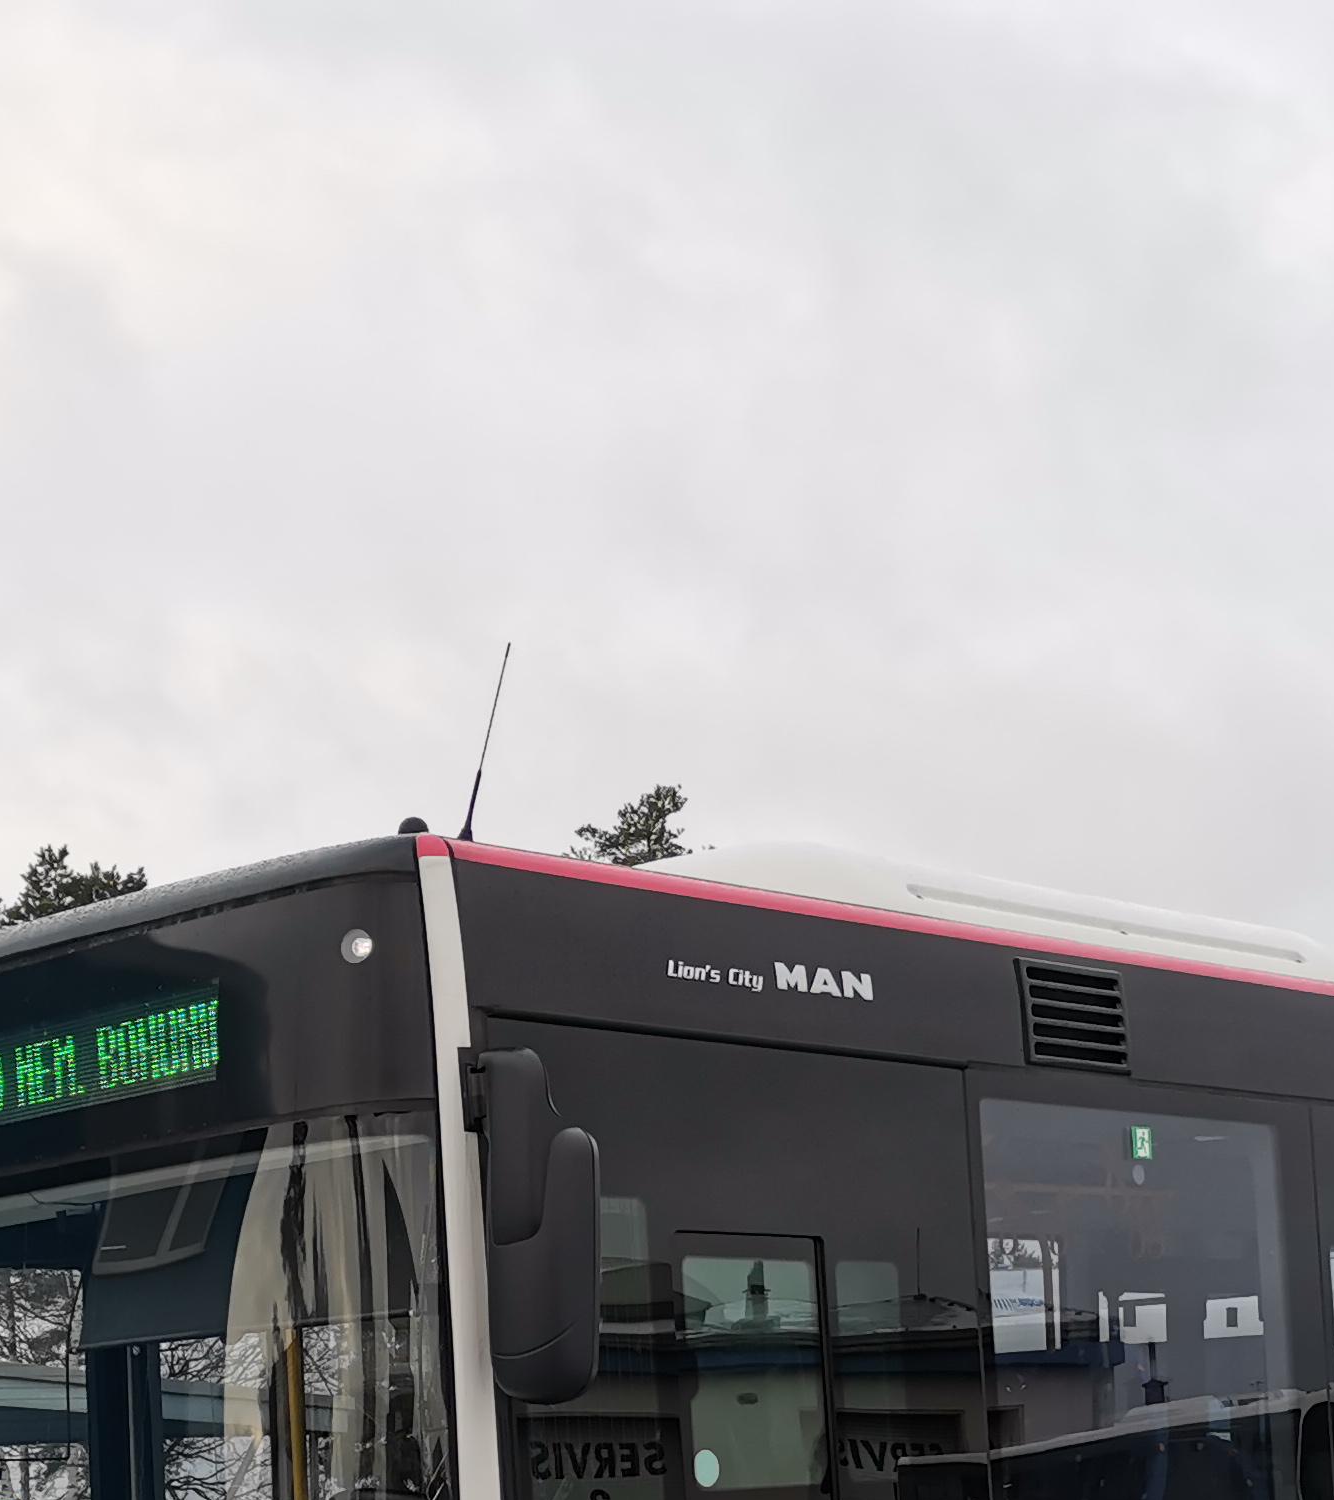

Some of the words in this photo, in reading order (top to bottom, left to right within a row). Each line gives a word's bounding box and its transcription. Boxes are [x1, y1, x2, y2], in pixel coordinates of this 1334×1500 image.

[667, 959, 721, 983] Lion's
[728, 967, 764, 992] City
[774, 961, 874, 1001] MAN
